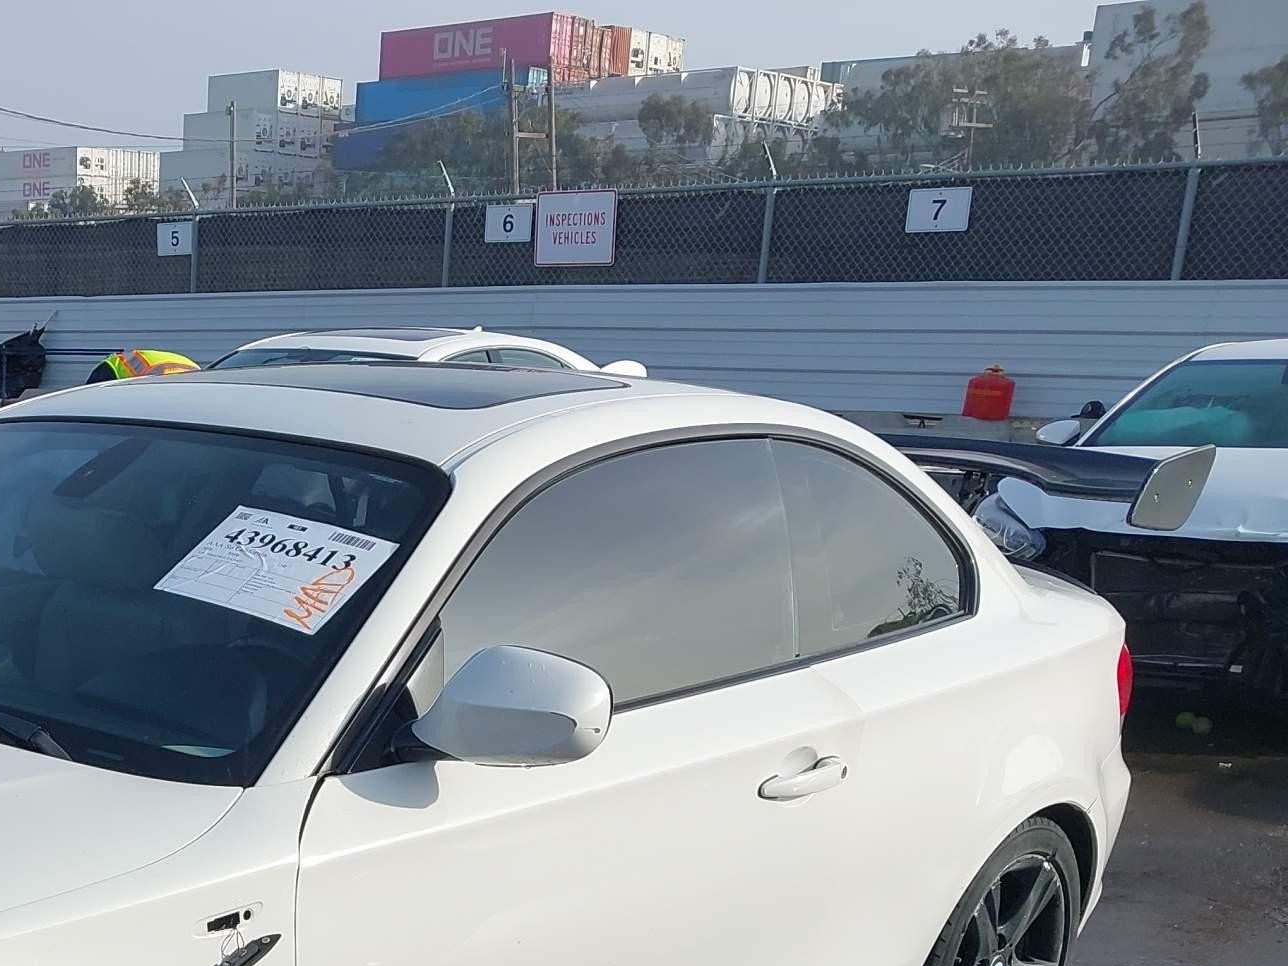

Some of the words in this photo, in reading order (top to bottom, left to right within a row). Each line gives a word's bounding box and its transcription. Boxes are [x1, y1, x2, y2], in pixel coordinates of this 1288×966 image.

[432, 27, 493, 60] ONE
[23, 152, 51, 169] ONE
[23, 181, 51, 198] ONE
[932, 199, 947, 221] 7
[502, 214, 514, 233] 6
[545, 211, 606, 227] INSPECTIONS
[171, 230, 180, 247] 5
[552, 231, 597, 245] VEHICLES
[224, 527, 357, 571] 43968413
